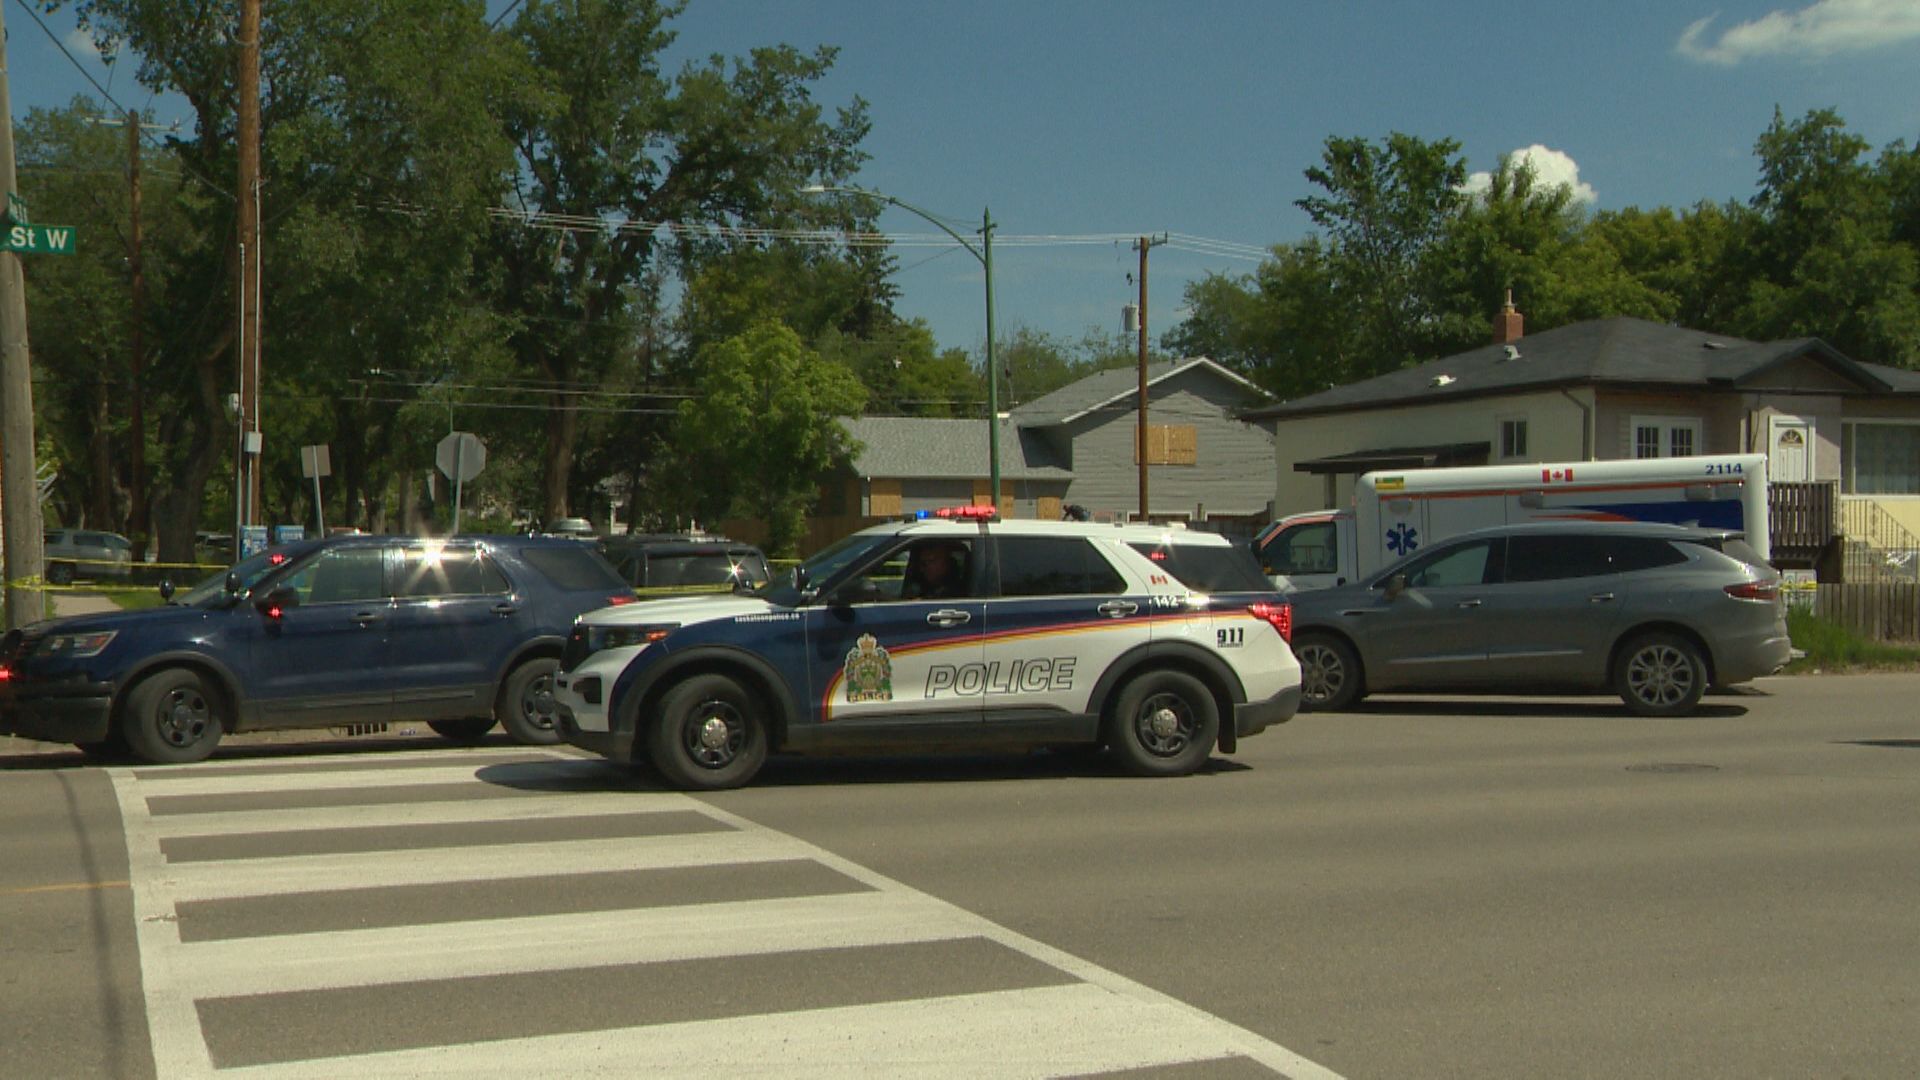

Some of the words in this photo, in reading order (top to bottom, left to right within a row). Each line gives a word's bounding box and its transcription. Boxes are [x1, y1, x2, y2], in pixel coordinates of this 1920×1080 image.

[11, 227, 36, 248] St
[46, 229, 68, 250] W
[1705, 463, 1743, 475] 2114
[1153, 596, 1179, 608] 142
[1217, 627, 1244, 642] 911
[924, 657, 1077, 699] POLICE
